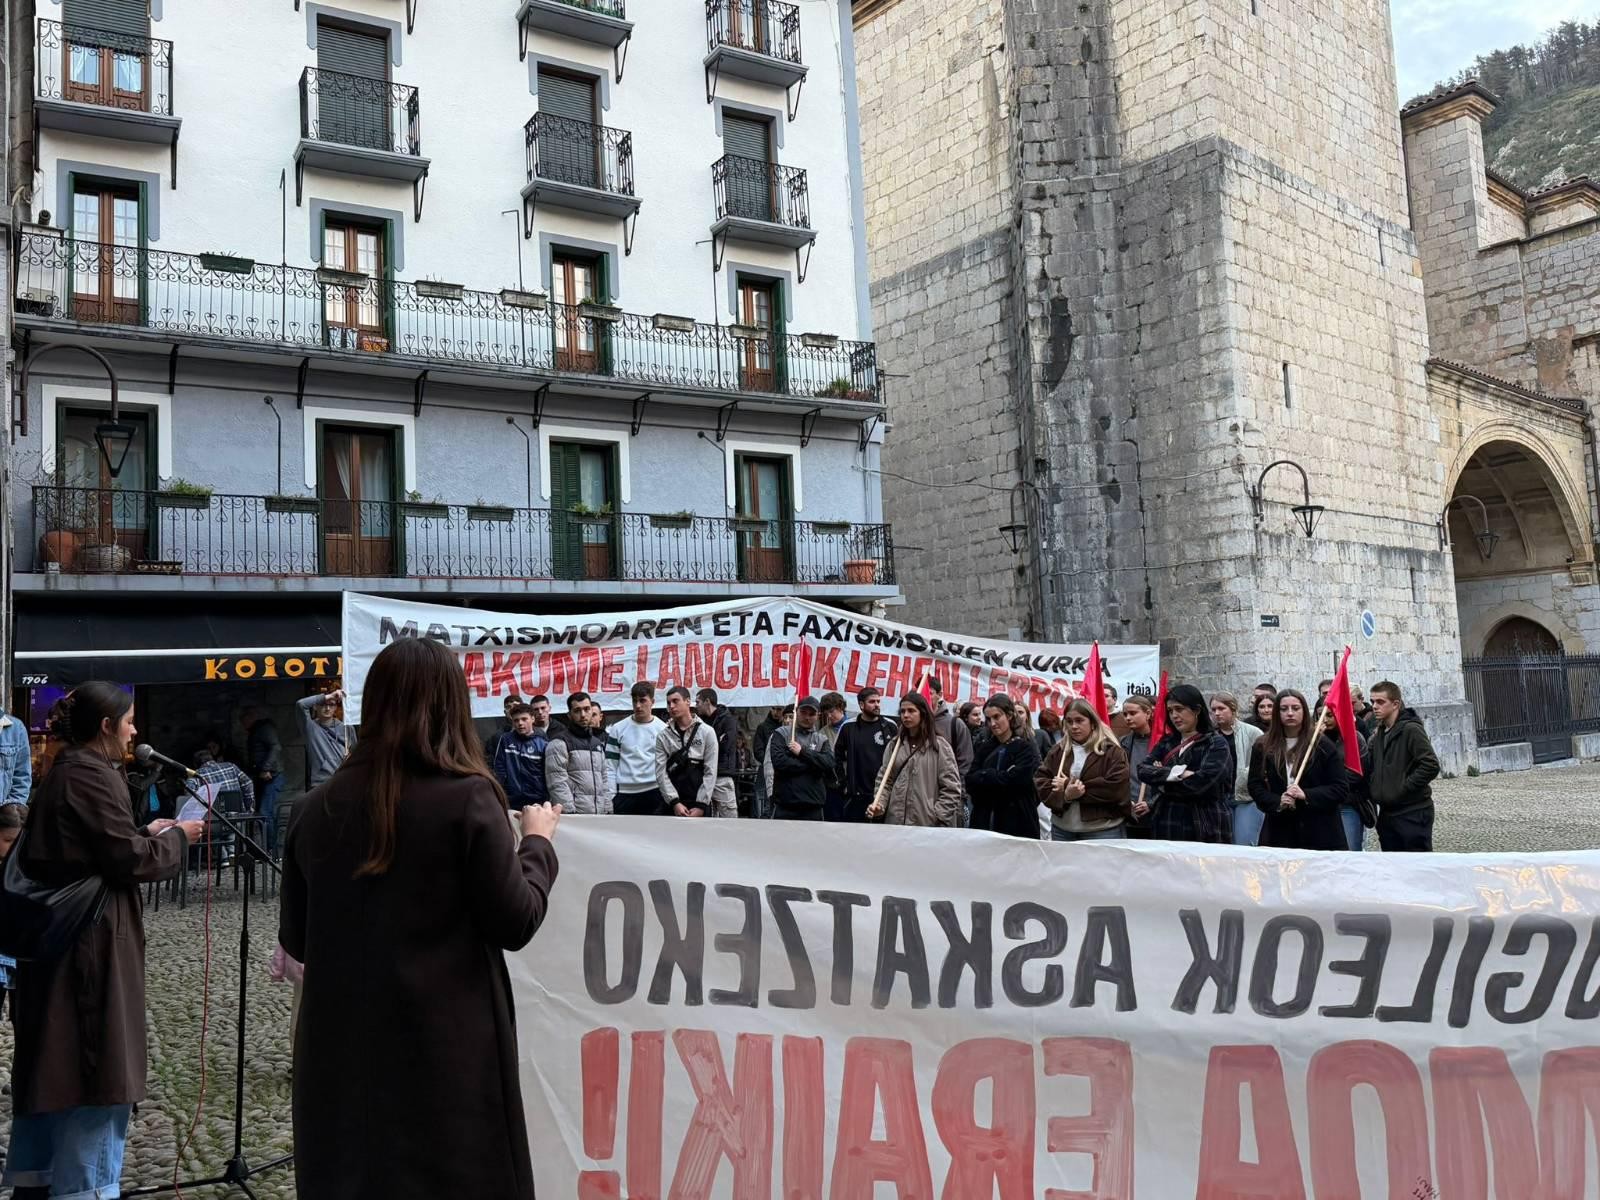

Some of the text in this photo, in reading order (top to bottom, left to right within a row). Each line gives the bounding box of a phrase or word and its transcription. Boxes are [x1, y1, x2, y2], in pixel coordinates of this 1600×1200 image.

[380, 616, 703, 647] MATXISMOAREN
[712, 611, 774, 637] ETA
[783, 612, 1008, 667] FAXISMOAREN
[22, 676, 48, 684] 1906
[456, 647, 624, 698] AKUME
[969, 664, 1087, 716] LERRO
